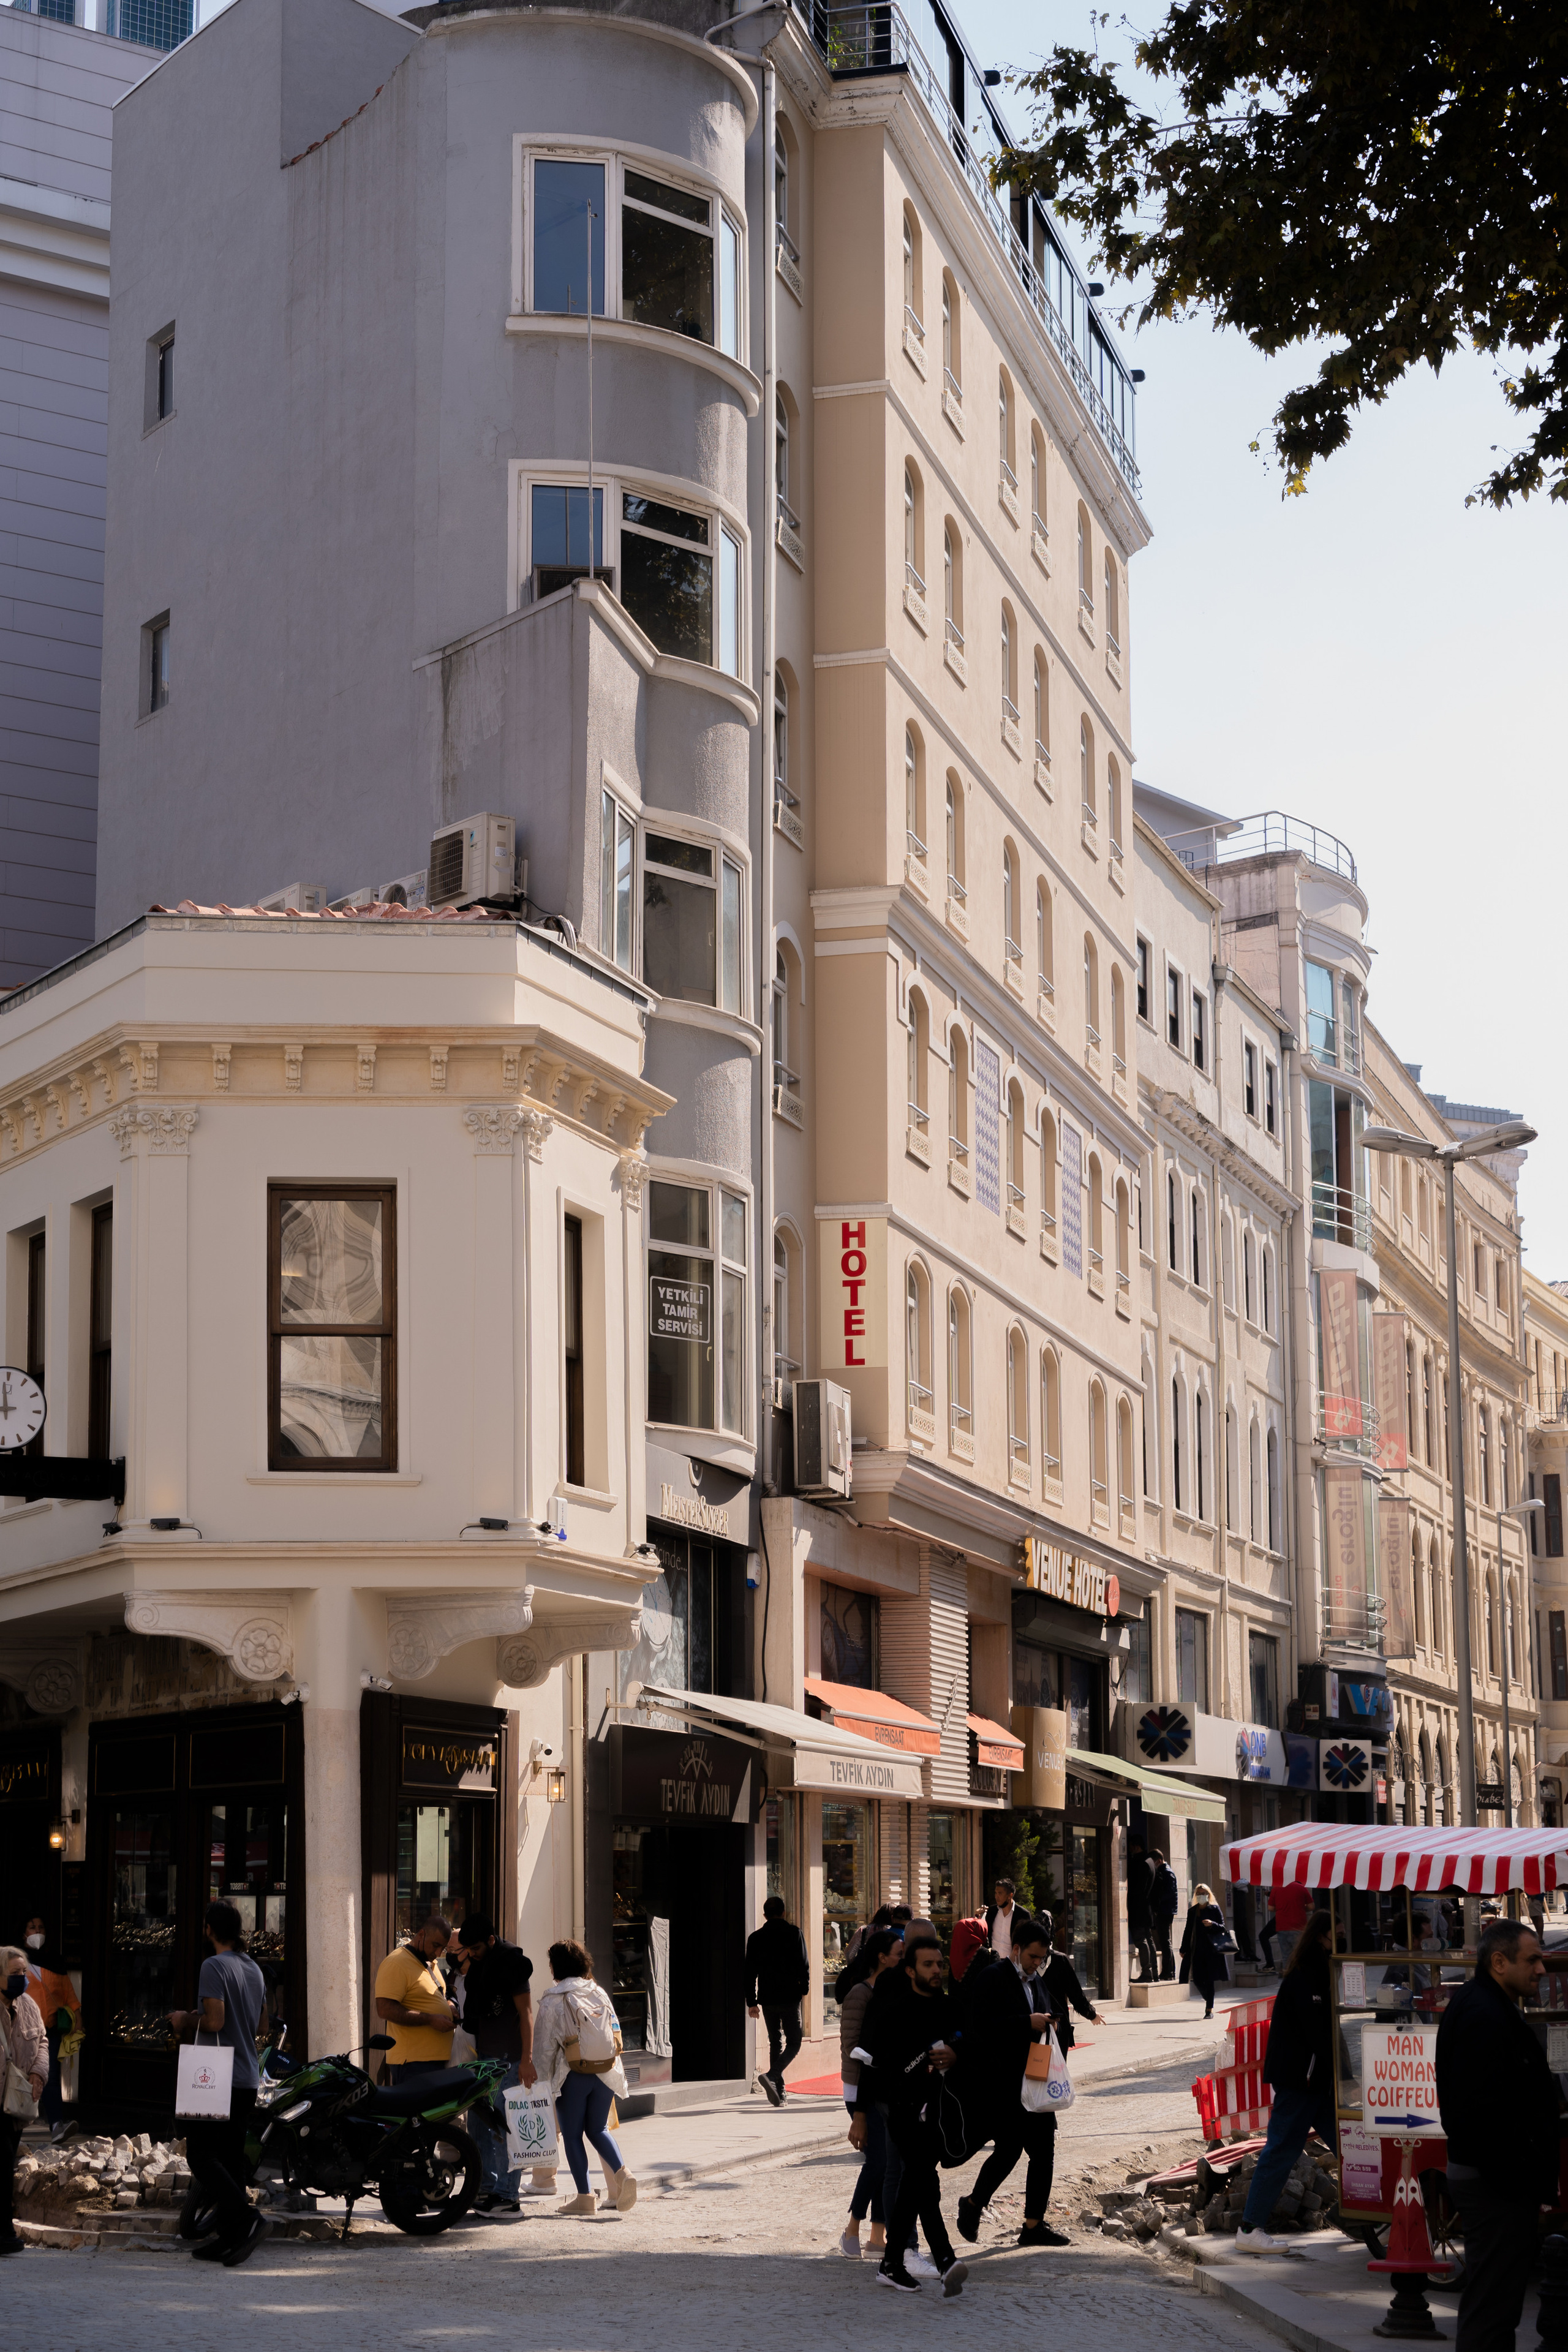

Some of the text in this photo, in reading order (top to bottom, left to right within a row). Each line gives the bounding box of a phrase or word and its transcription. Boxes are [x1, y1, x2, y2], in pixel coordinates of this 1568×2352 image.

[657, 1286, 704, 1305] YETKİLİ
[840, 1221, 867, 1366] HOTEL
[662, 1303, 698, 1320] TAMİR
[657, 1318, 703, 1336] SERVİSİ
[1031, 1537, 1107, 1616] VENUE HOTEL
[1250, 1730, 1267, 1757] QNB
[1037, 1751, 1061, 1770] VENUE
[830, 1758, 894, 1789] TEVFİK AYDIN
[968, 1764, 1007, 1793] XCLUSIVE
[660, 1778, 730, 1816] TEVFİK AYDIN
[1387, 2035, 1423, 2056] MAN
[904, 2051, 927, 2073] adidas
[1374, 2060, 1437, 2082] WOMAN
[508, 2101, 529, 2110] DOLAC
[1367, 2086, 1440, 2108] COIFFEU
[1355, 2143, 1379, 2152] BELEDİYES
